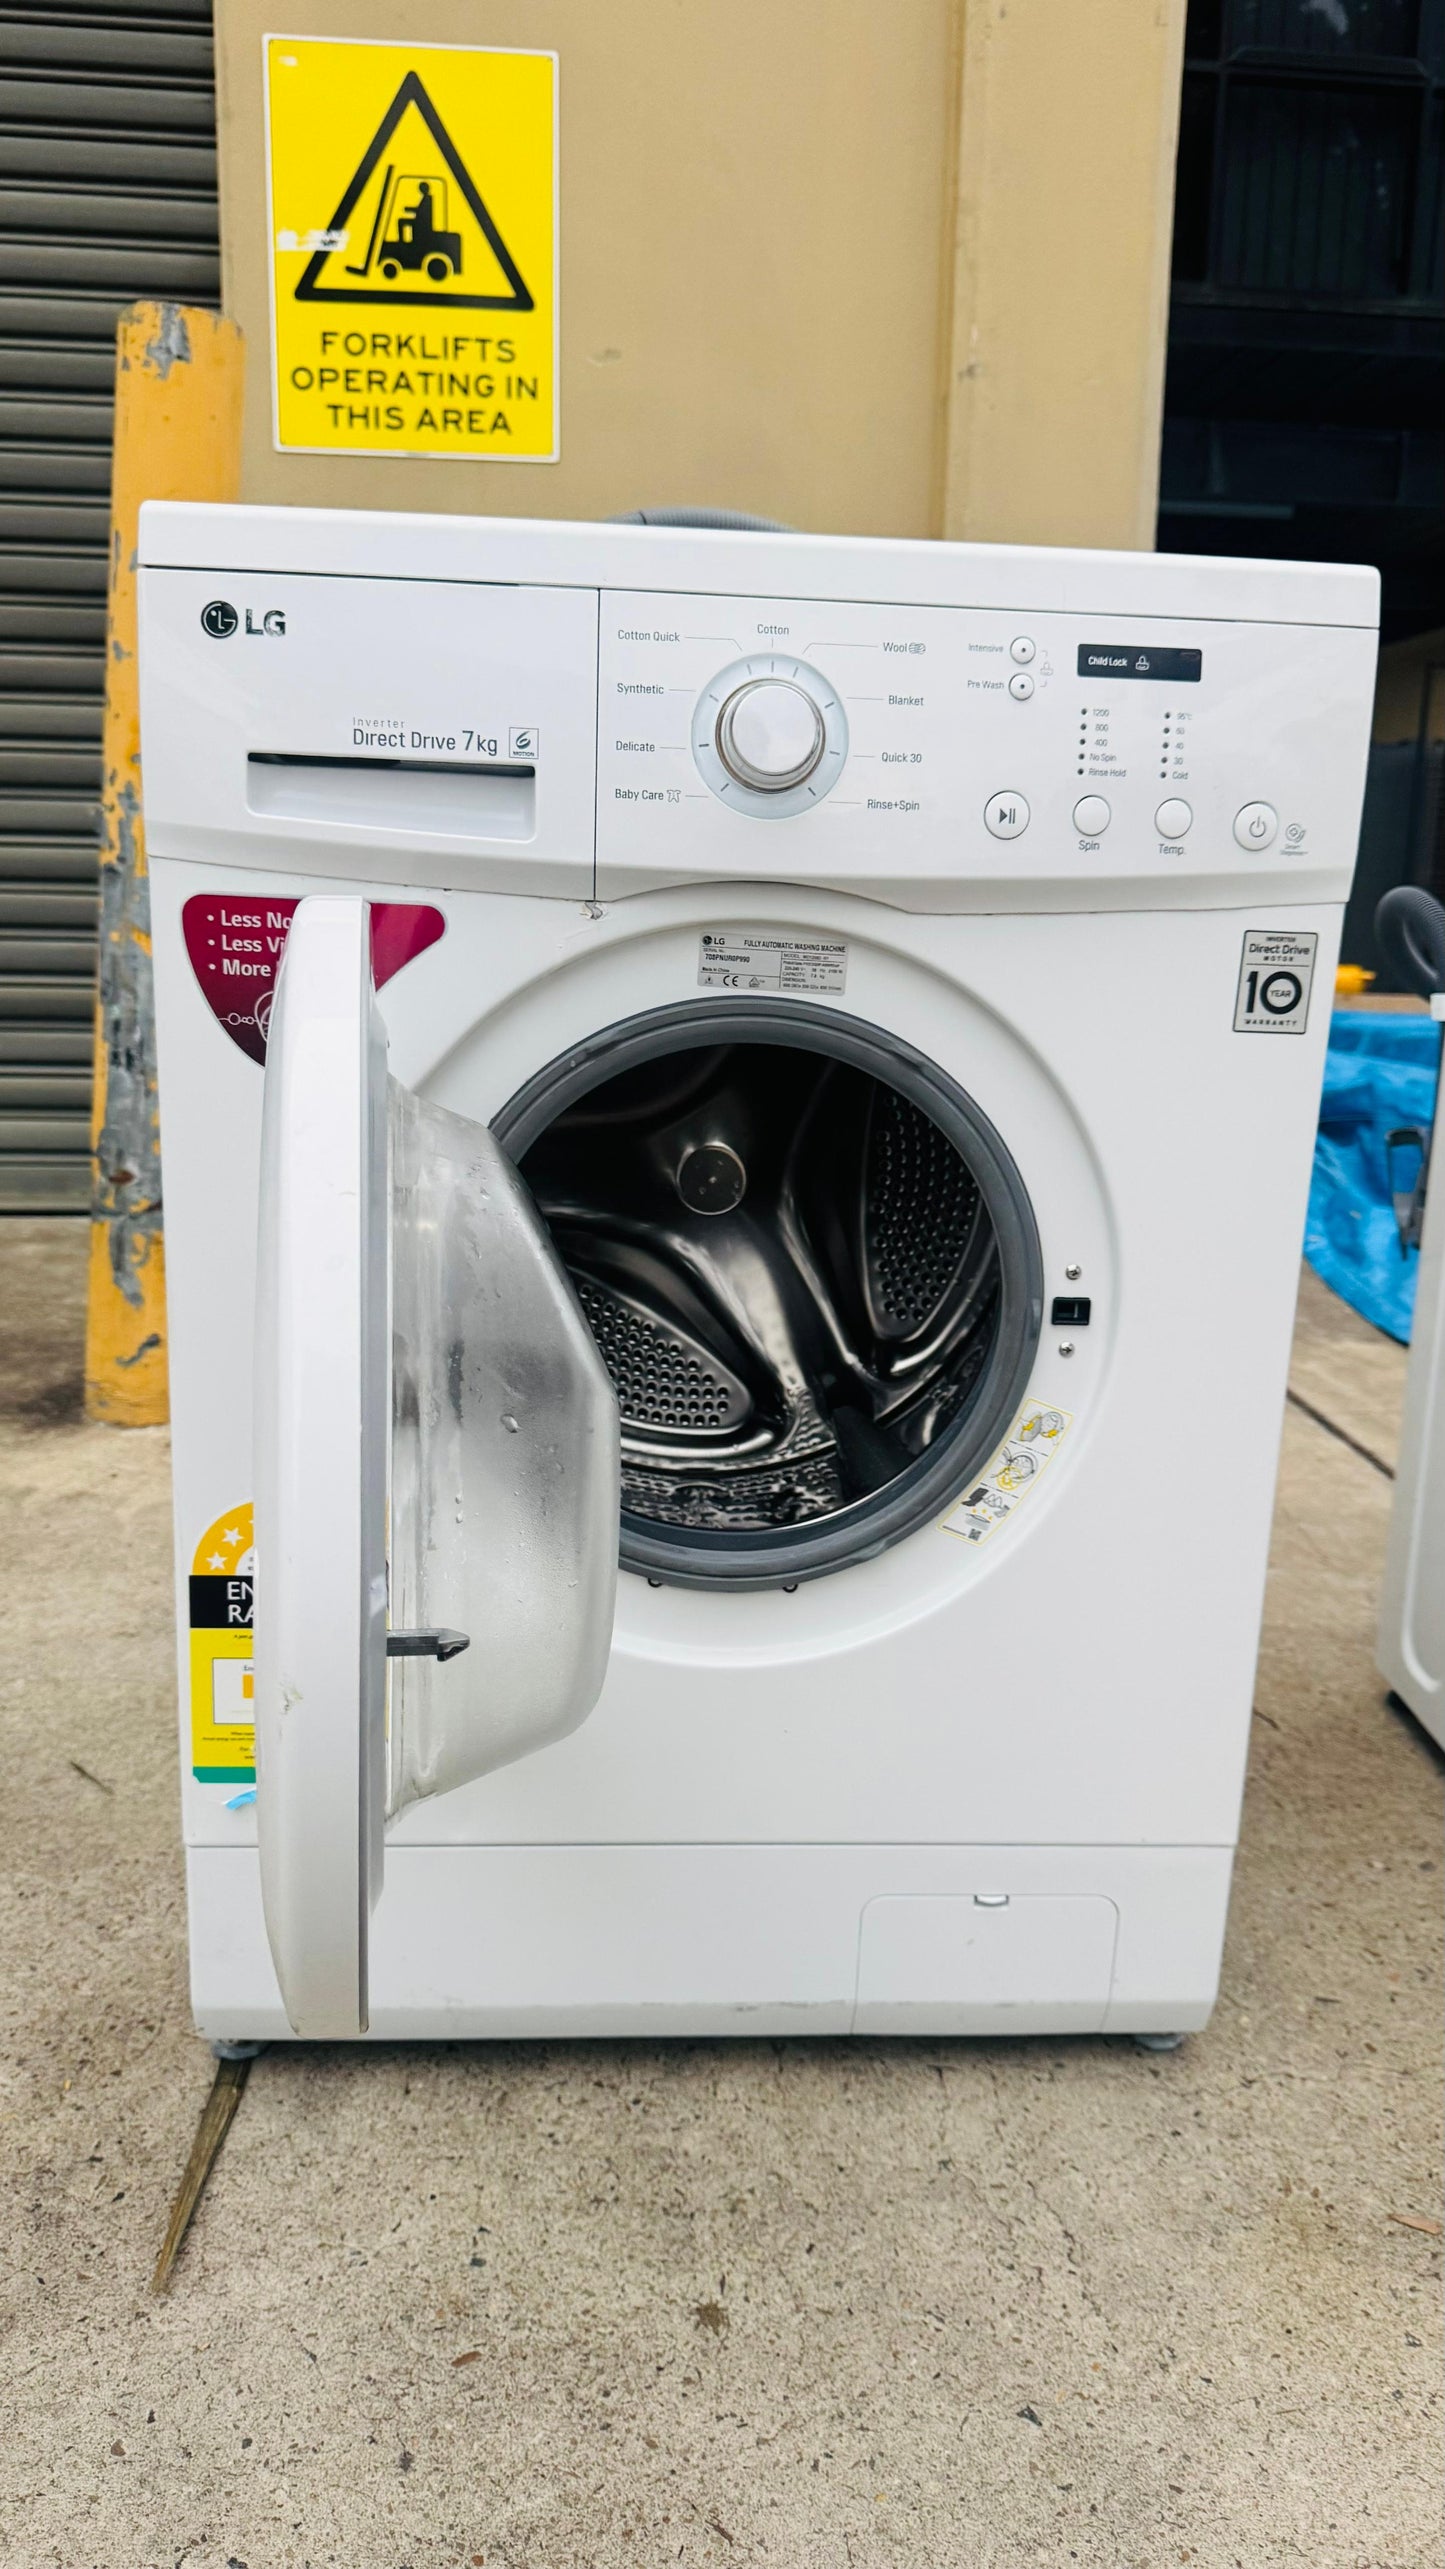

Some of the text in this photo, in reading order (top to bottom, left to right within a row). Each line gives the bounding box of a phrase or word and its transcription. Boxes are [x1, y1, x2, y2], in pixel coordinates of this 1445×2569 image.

[320, 331, 516, 364] FORKLIFTS
[291, 367, 538, 400] OPERATING IN
[326, 404, 512, 435] THIS AREA
[245, 608, 287, 637] LG
[757, 624, 789, 636] Cotton
[617, 629, 680, 644] Cotton Quick
[883, 641, 907, 653] Wool
[968, 643, 1004, 653] Intensive
[1088, 655, 1127, 668] Child Lock
[616, 682, 664, 695] Synthetic
[967, 680, 1004, 690] Pre Wash
[888, 695, 924, 707] Blanket
[1092, 708, 1110, 717] 1200
[352, 717, 406, 728] Inverter
[353, 728, 405, 748] Direct
[411, 731, 456, 751] Drive
[1094, 738, 1108, 747] 400
[616, 741, 655, 752] Delicate
[882, 752, 922, 764] Quick 30
[1089, 753, 1117, 764] No Spin
[1173, 756, 1183, 765] 30
[1088, 768, 1127, 778] Rinse Hold
[1172, 771, 1189, 780] Cold
[615, 789, 664, 802] Baby Care
[867, 799, 920, 812] Rinse+Spin
[1078, 840, 1100, 852] Spin
[221, 910, 262, 929] Less
[221, 934, 262, 953] Less
[714, 937, 725, 946] LG
[744, 939, 846, 953] FULLY AUTOMATIC WASHING MACHINE
[1249, 943, 1310, 955] Direct Drive
[222, 959, 271, 977] More
[1246, 971, 1302, 1015] 10
